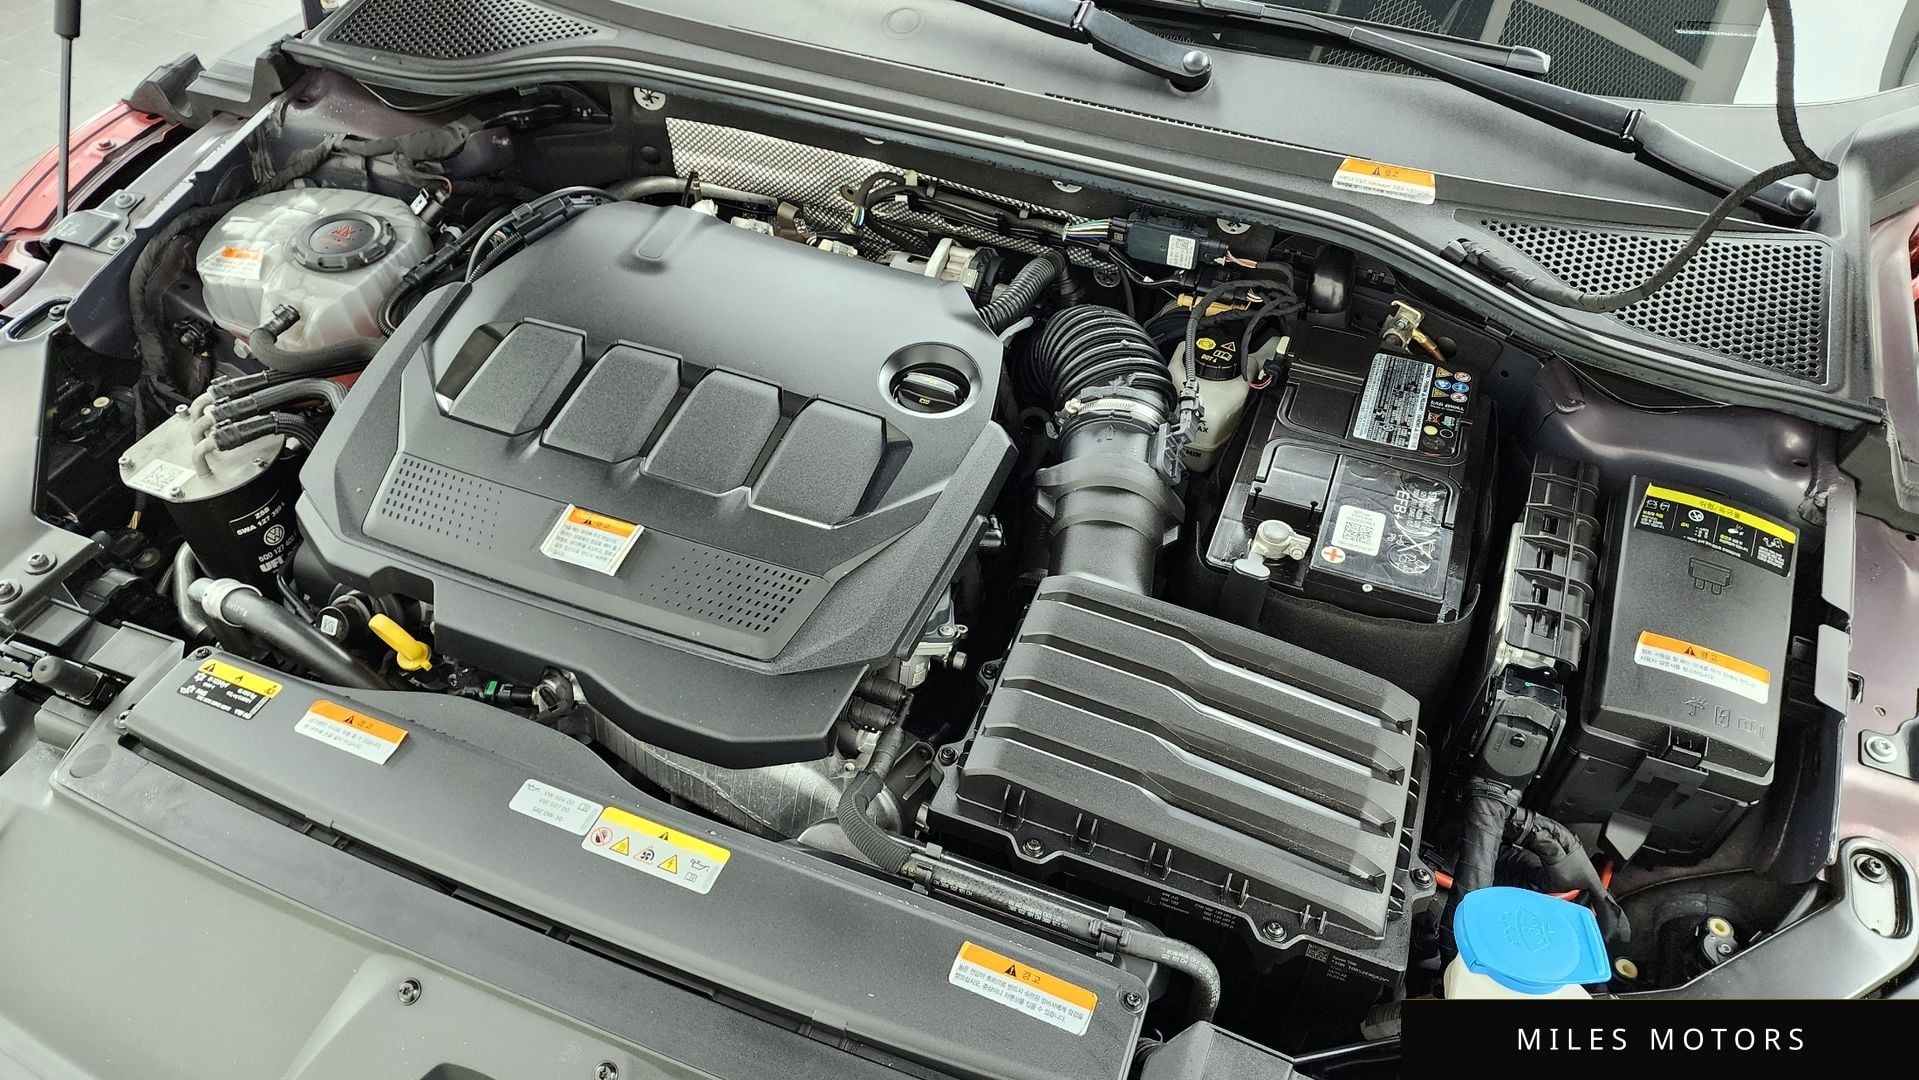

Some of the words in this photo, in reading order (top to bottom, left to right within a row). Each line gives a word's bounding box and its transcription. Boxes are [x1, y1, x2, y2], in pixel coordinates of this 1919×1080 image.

[1393, 490, 1410, 520] EFB+
[257, 516, 270, 526] 127
[258, 552, 273, 562] 5Q0
[273, 544, 285, 554] 127
[1022, 970, 1041, 984] 경고
[1007, 981, 1024, 992] 반드시
